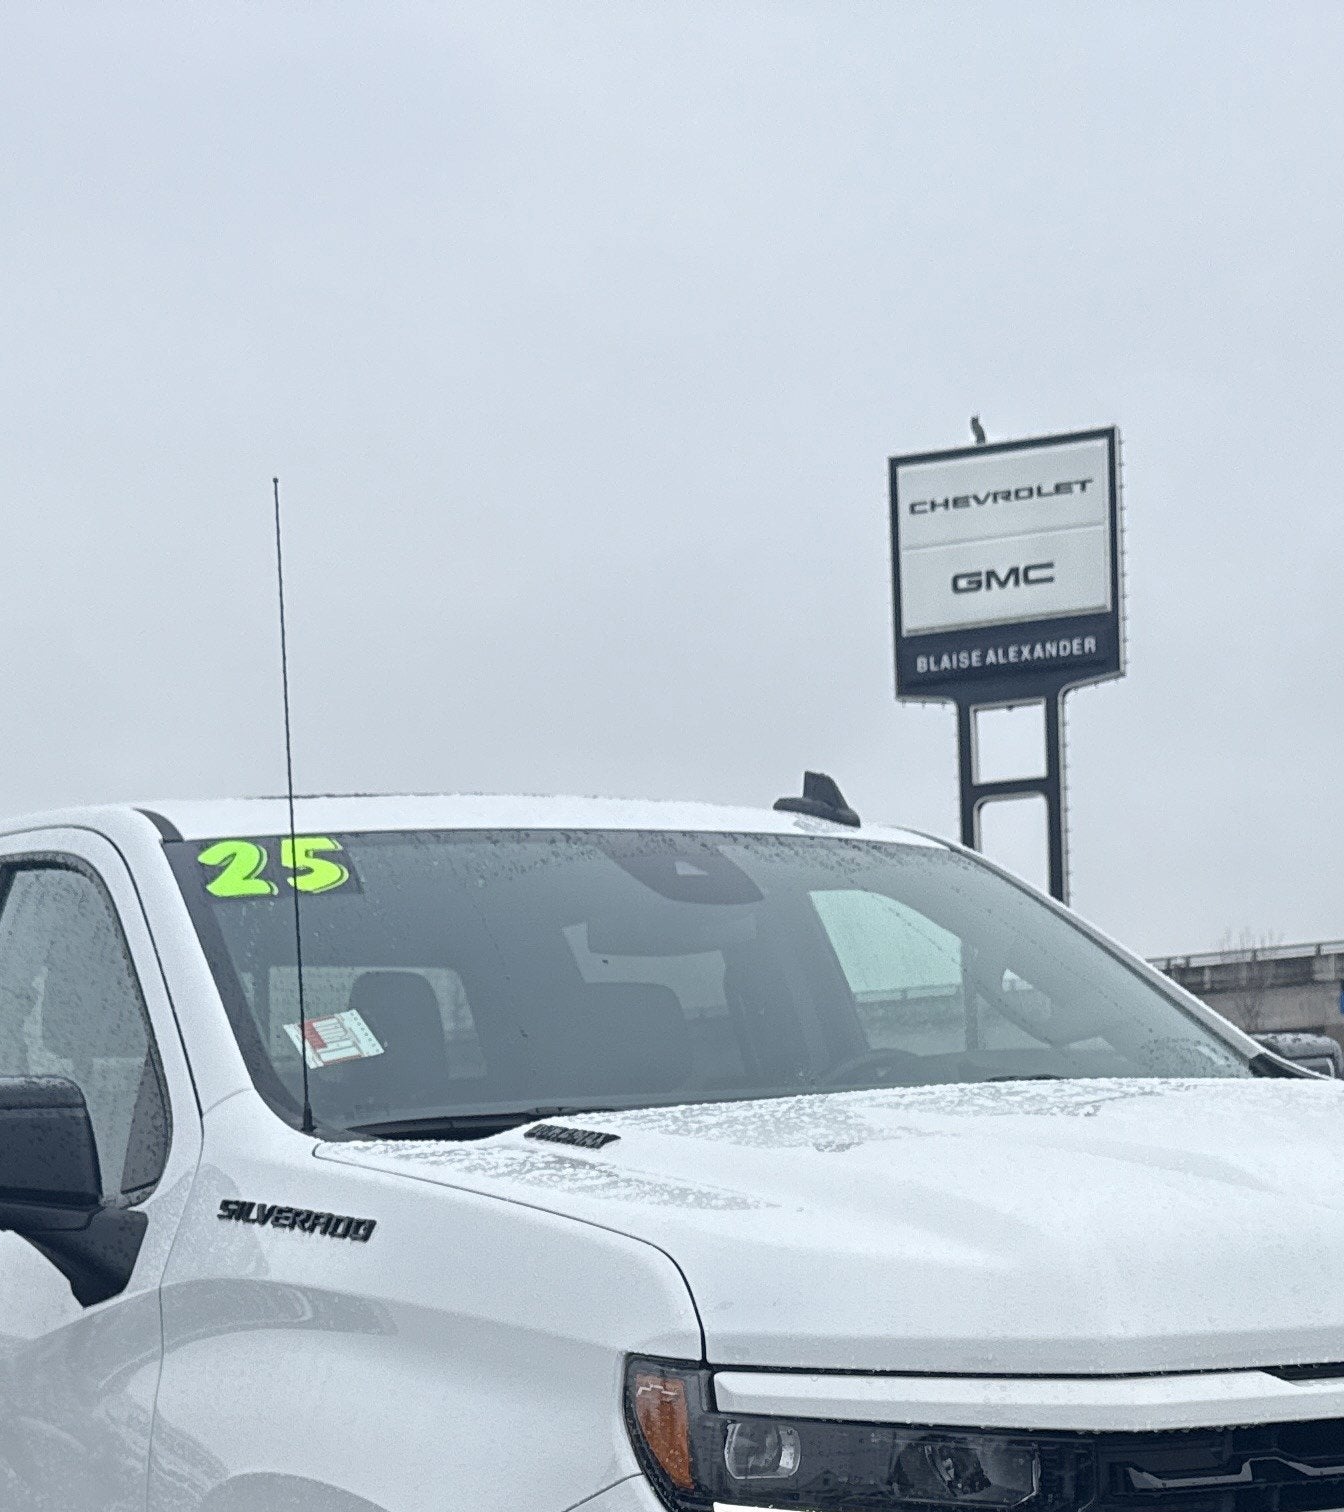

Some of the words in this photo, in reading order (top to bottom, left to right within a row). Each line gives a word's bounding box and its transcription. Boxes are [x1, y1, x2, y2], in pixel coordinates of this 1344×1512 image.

[908, 478, 1094, 515] CHEVROLET
[951, 561, 1055, 595] GMC
[915, 650, 983, 673] BLAISE
[984, 635, 1097, 665] ALEXANDER
[197, 836, 351, 898] 25
[217, 1199, 377, 1243] SILVERADO
